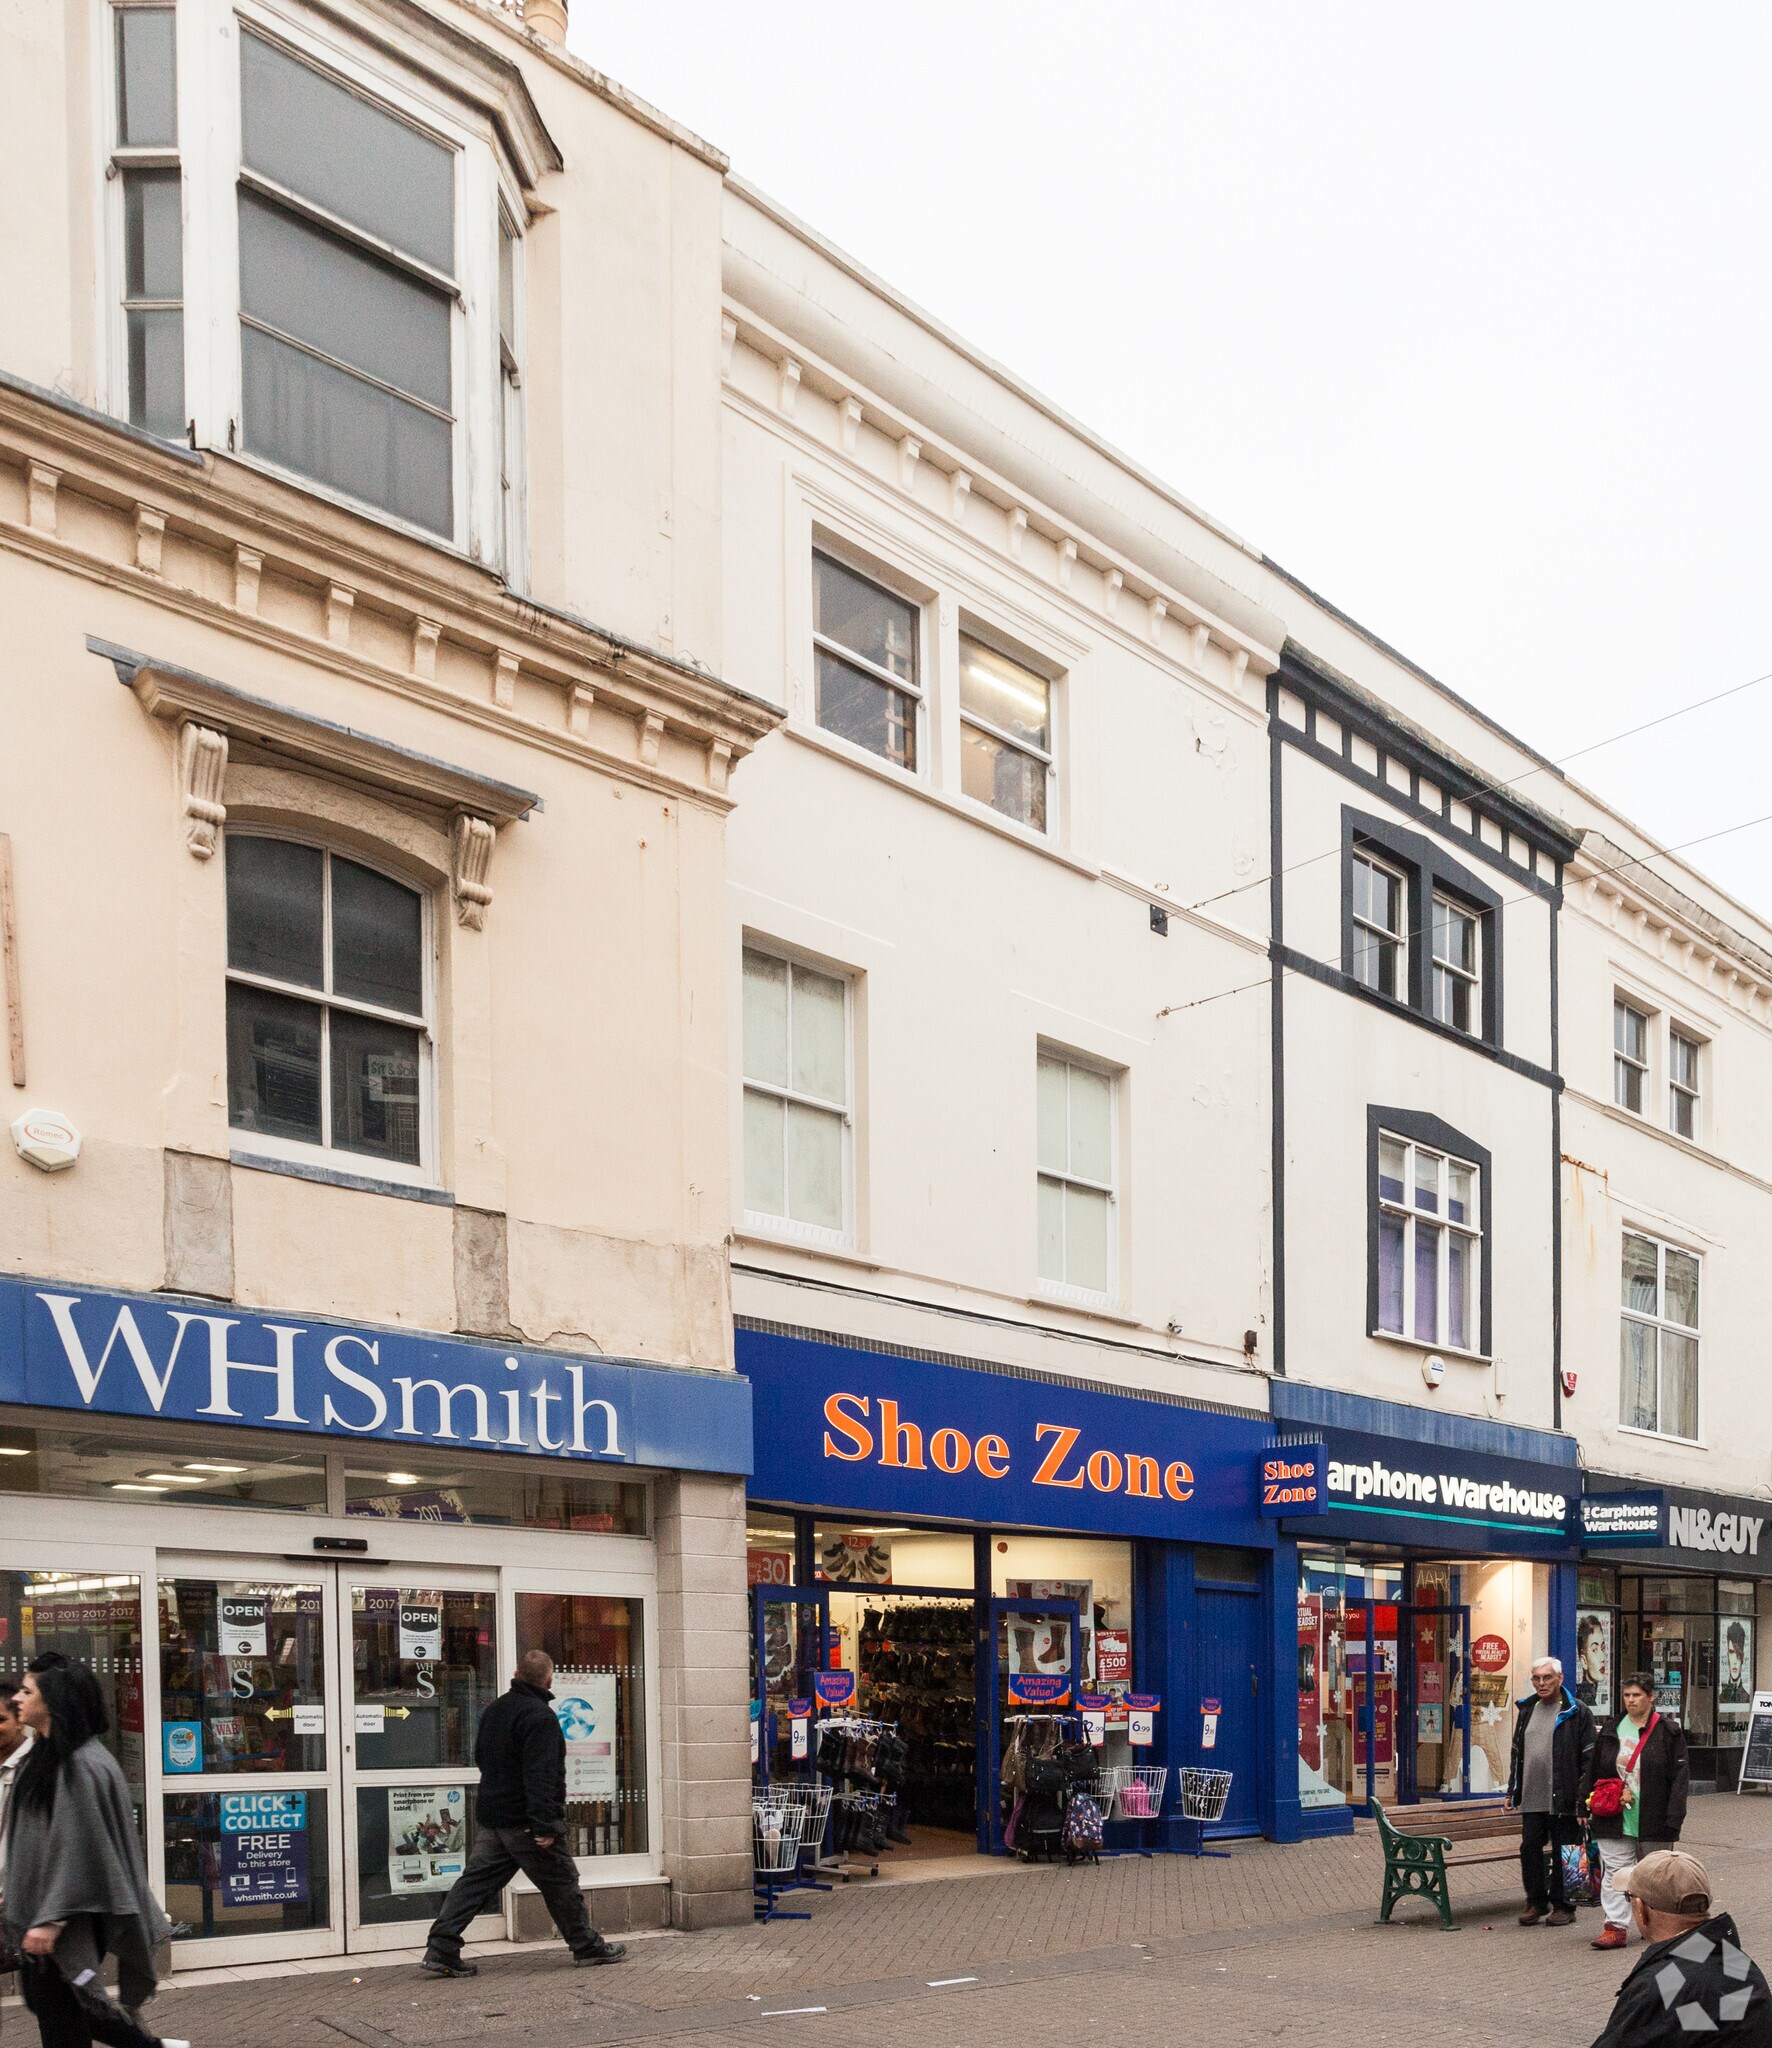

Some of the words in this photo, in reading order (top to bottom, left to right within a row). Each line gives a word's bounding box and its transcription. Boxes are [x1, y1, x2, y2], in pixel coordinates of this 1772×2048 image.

[36, 1292, 627, 1457] WHSmith
[823, 1392, 1010, 1479] Shoe
[1032, 1422, 1194, 1501] Zone
[1264, 1461, 1315, 1480] Shoe
[1263, 1484, 1317, 1504] Zone
[1327, 1461, 1437, 1504] arphone
[1438, 1475, 1566, 1520] Warehouse
[1591, 1504, 1658, 1519] Carphone
[1584, 1519, 1658, 1532] Warehouse
[1669, 1505, 1764, 1555] NI&GUY
[300, 1600, 320, 1610] 201
[369, 1598, 395, 1610] 2017
[36, 1611, 54, 1620] 201
[82, 1609, 107, 1618] 2017
[110, 1607, 134, 1616] 2017
[223, 1605, 264, 1617] OPEN
[402, 1612, 438, 1623] OPEN
[1298, 1616, 1318, 1626] EADSET
[232, 1660, 252, 1669] WH
[416, 1662, 434, 1671] WH
[1099, 1657, 1127, 1668] £500
[232, 1669, 254, 1699] S
[416, 1670, 435, 1699] S
[820, 1676, 850, 1687] Amazing
[1017, 1676, 1062, 1687] Amazing
[825, 1687, 846, 1697] Value!
[1024, 1686, 1055, 1696] Value!
[1132, 1721, 1151, 1732] 6.99
[793, 1730, 806, 1743] 9.99
[225, 1813, 302, 1830] COLLECT
[237, 1834, 291, 1851] FREE
[246, 1851, 283, 1860] Delivery
[250, 1860, 266, 1868] this
[268, 1859, 291, 1867] store
[234, 1891, 298, 1902] whsmith.co.uk
